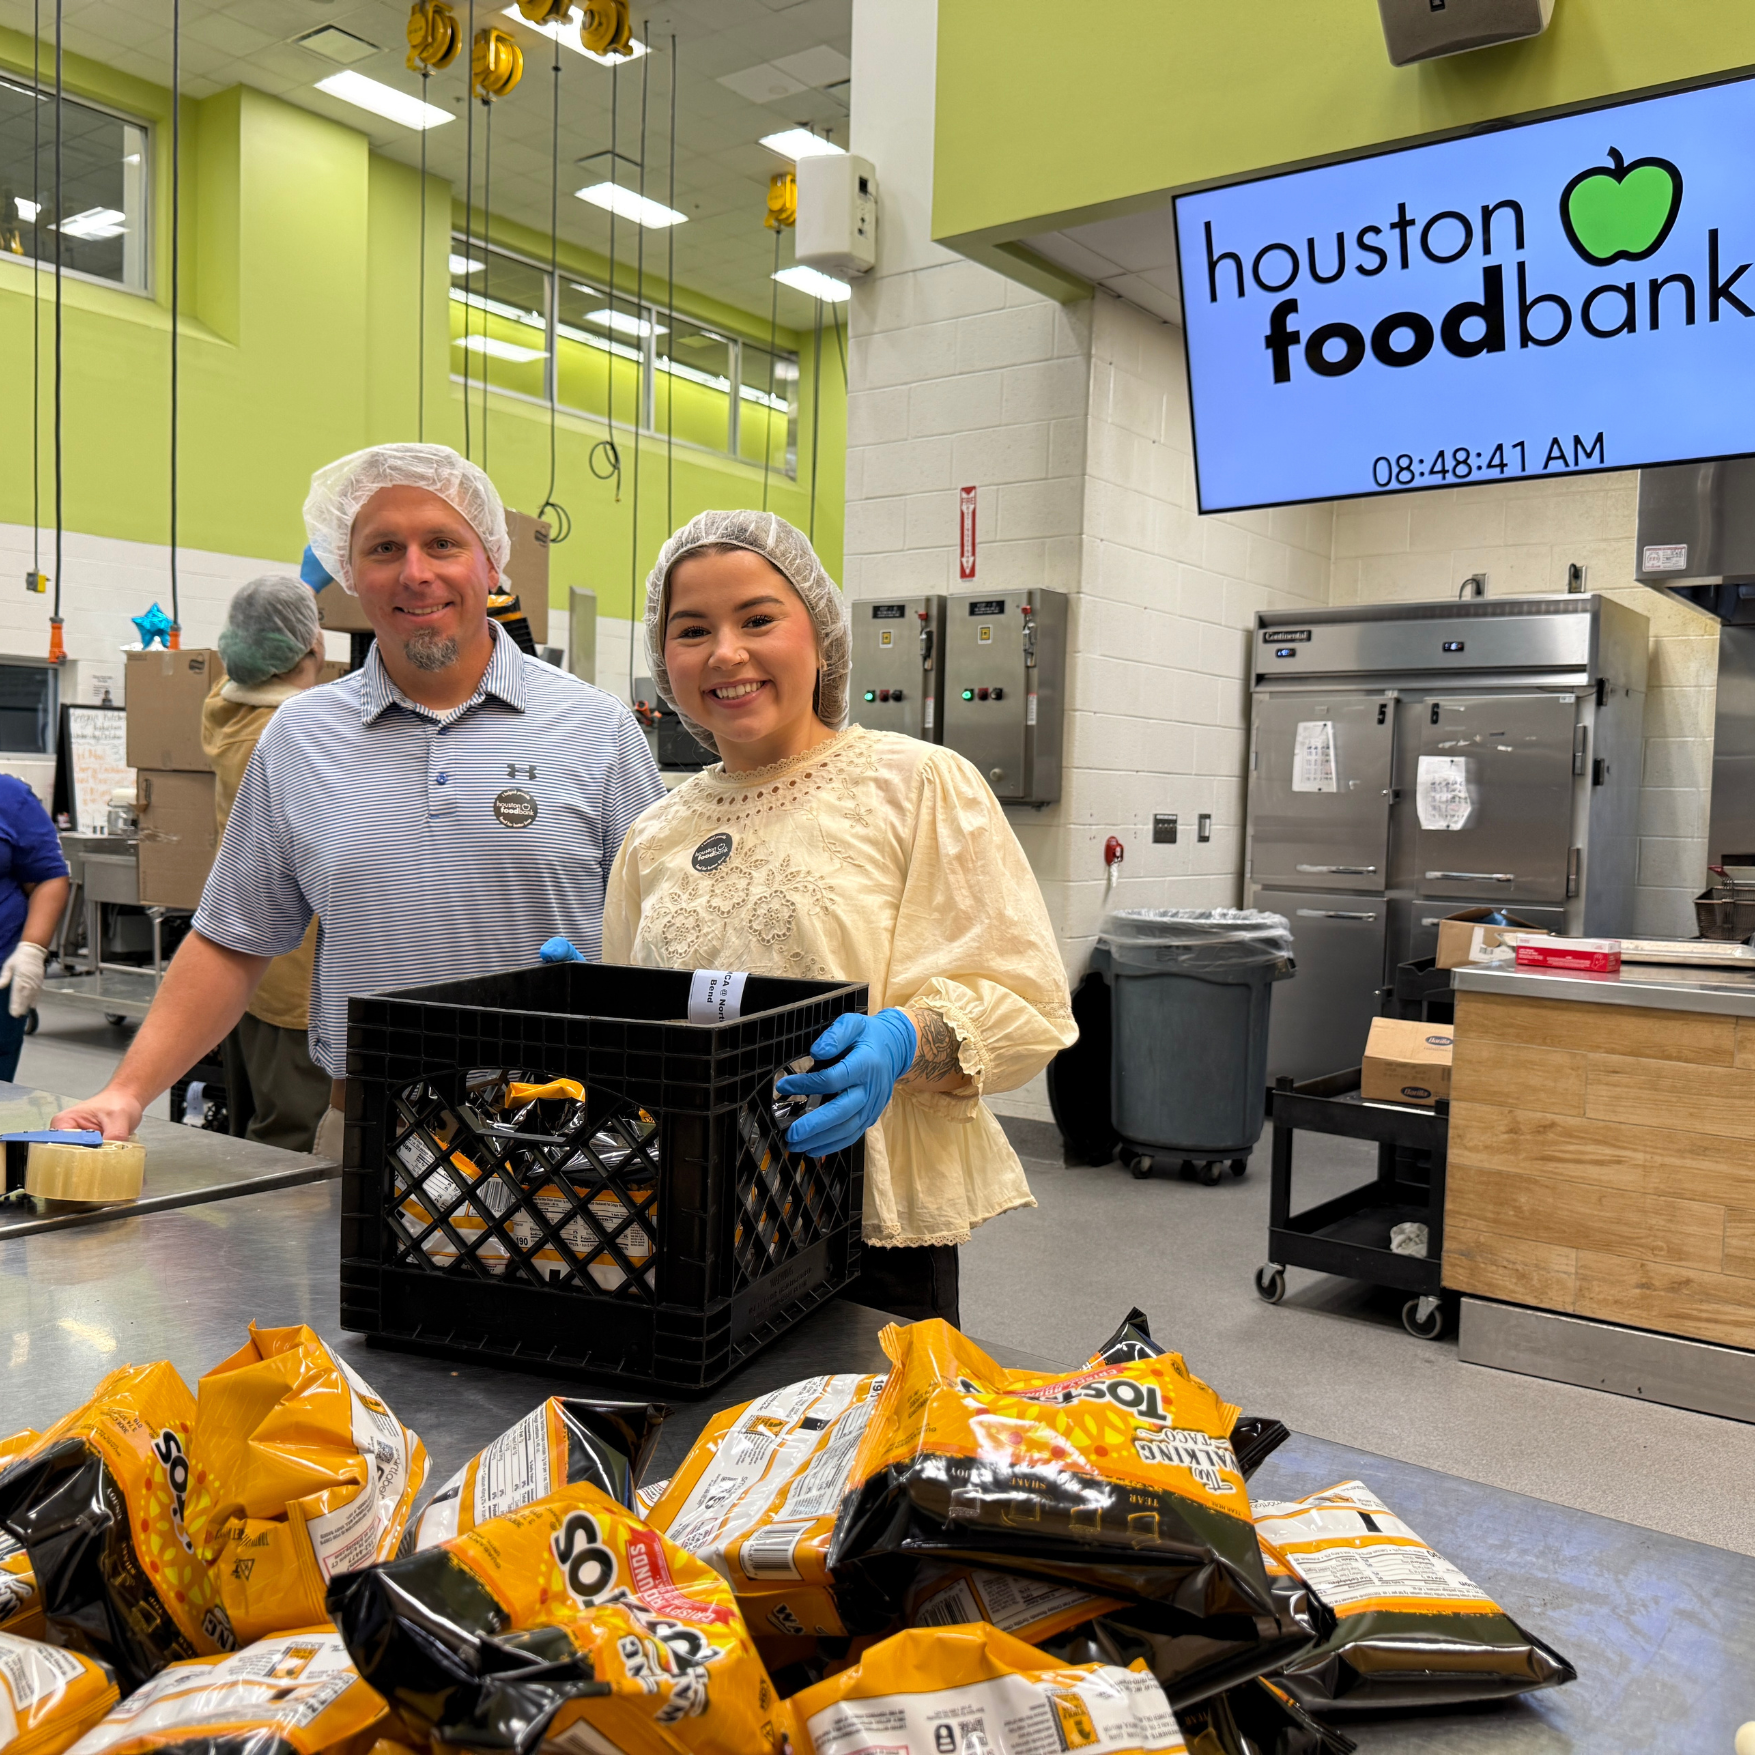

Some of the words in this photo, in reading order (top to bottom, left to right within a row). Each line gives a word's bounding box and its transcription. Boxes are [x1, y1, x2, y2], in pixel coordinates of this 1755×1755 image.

[1204, 199, 1525, 304] houston
[1264, 228, 1755, 384] foodbank
[1371, 439, 1528, 489] 08:48:41
[1542, 431, 1606, 471] AM
[1377, 703, 1388, 725] 5
[1430, 703, 1440, 725] 6
[496, 800, 521, 808] houston
[500, 806, 535, 816] foodbank
[722, 971, 733, 987] CA
[706, 979, 718, 1004] Bend
[1164, 1429, 1212, 1447] TACO
[1193, 1467, 1234, 1492] The
[1129, 1494, 1159, 1508] TEAR
